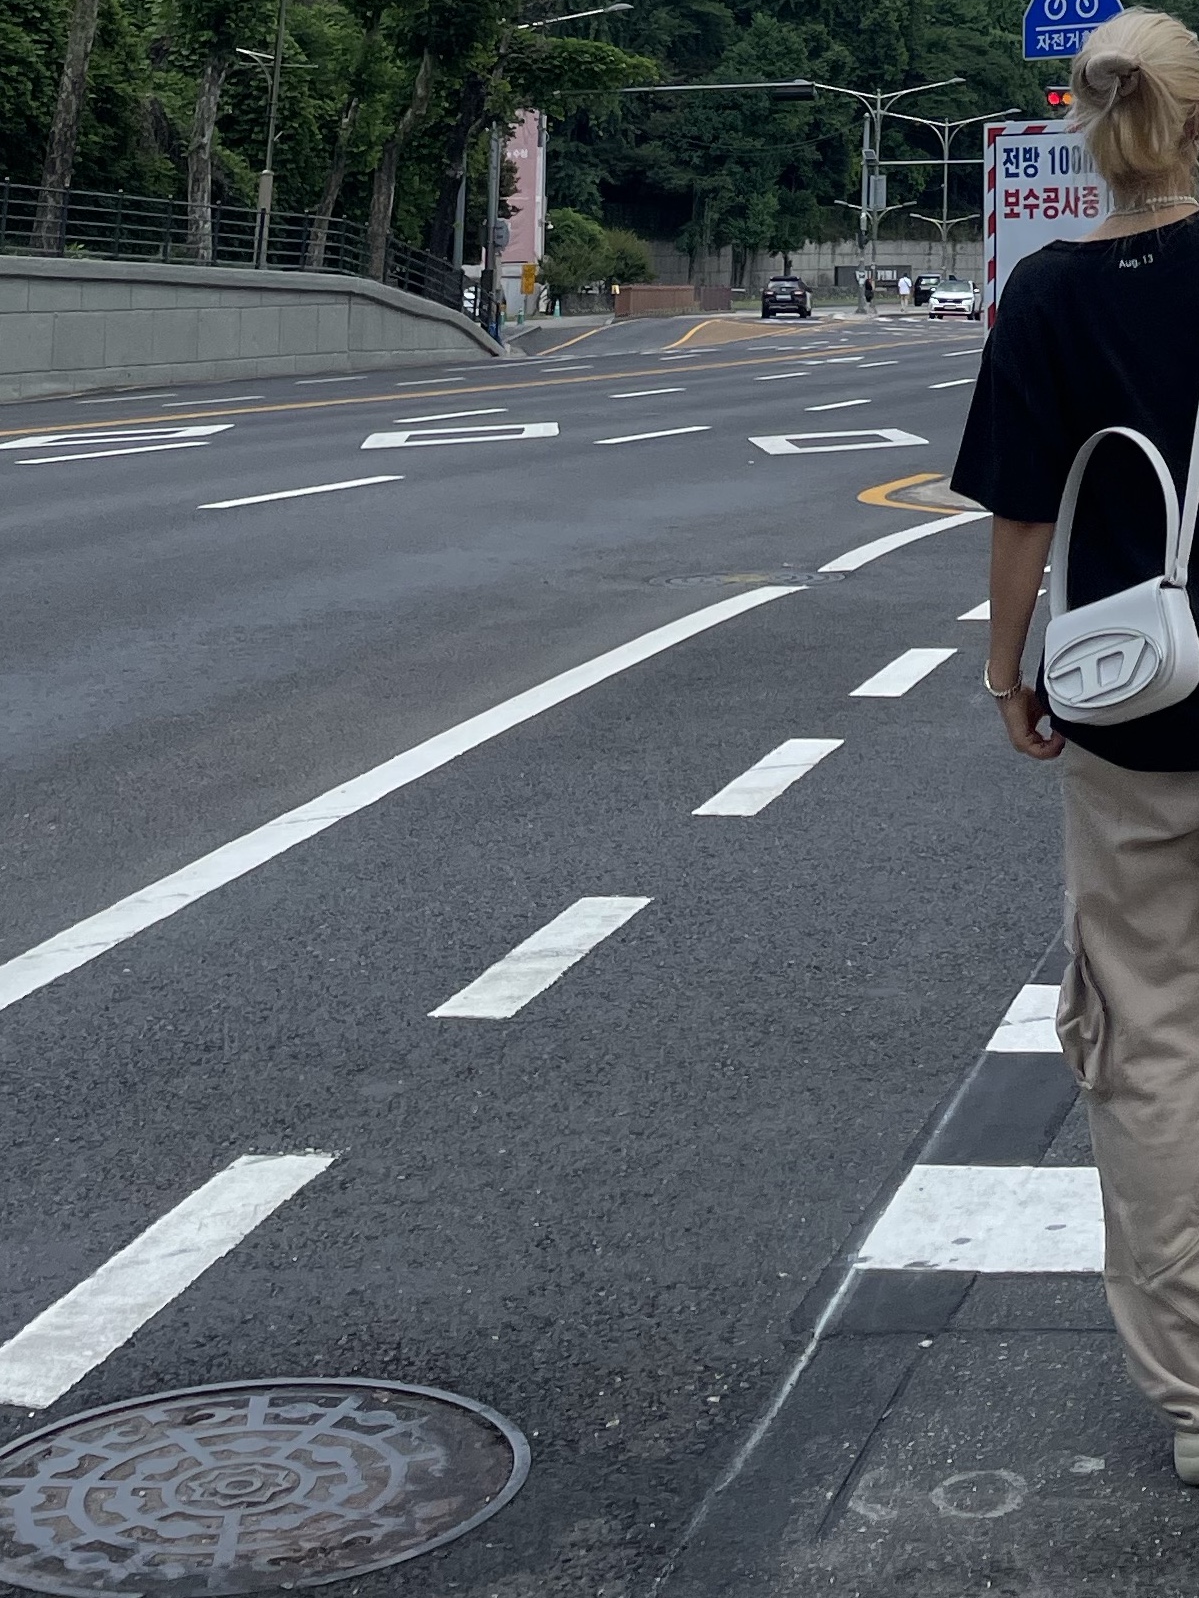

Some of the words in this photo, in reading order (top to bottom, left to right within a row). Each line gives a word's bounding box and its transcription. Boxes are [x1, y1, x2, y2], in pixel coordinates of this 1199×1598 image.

[1003, 146, 1040, 178] 전방
[1004, 186, 1099, 220] 보수공사중
[1143, 253, 1154, 264] 13
